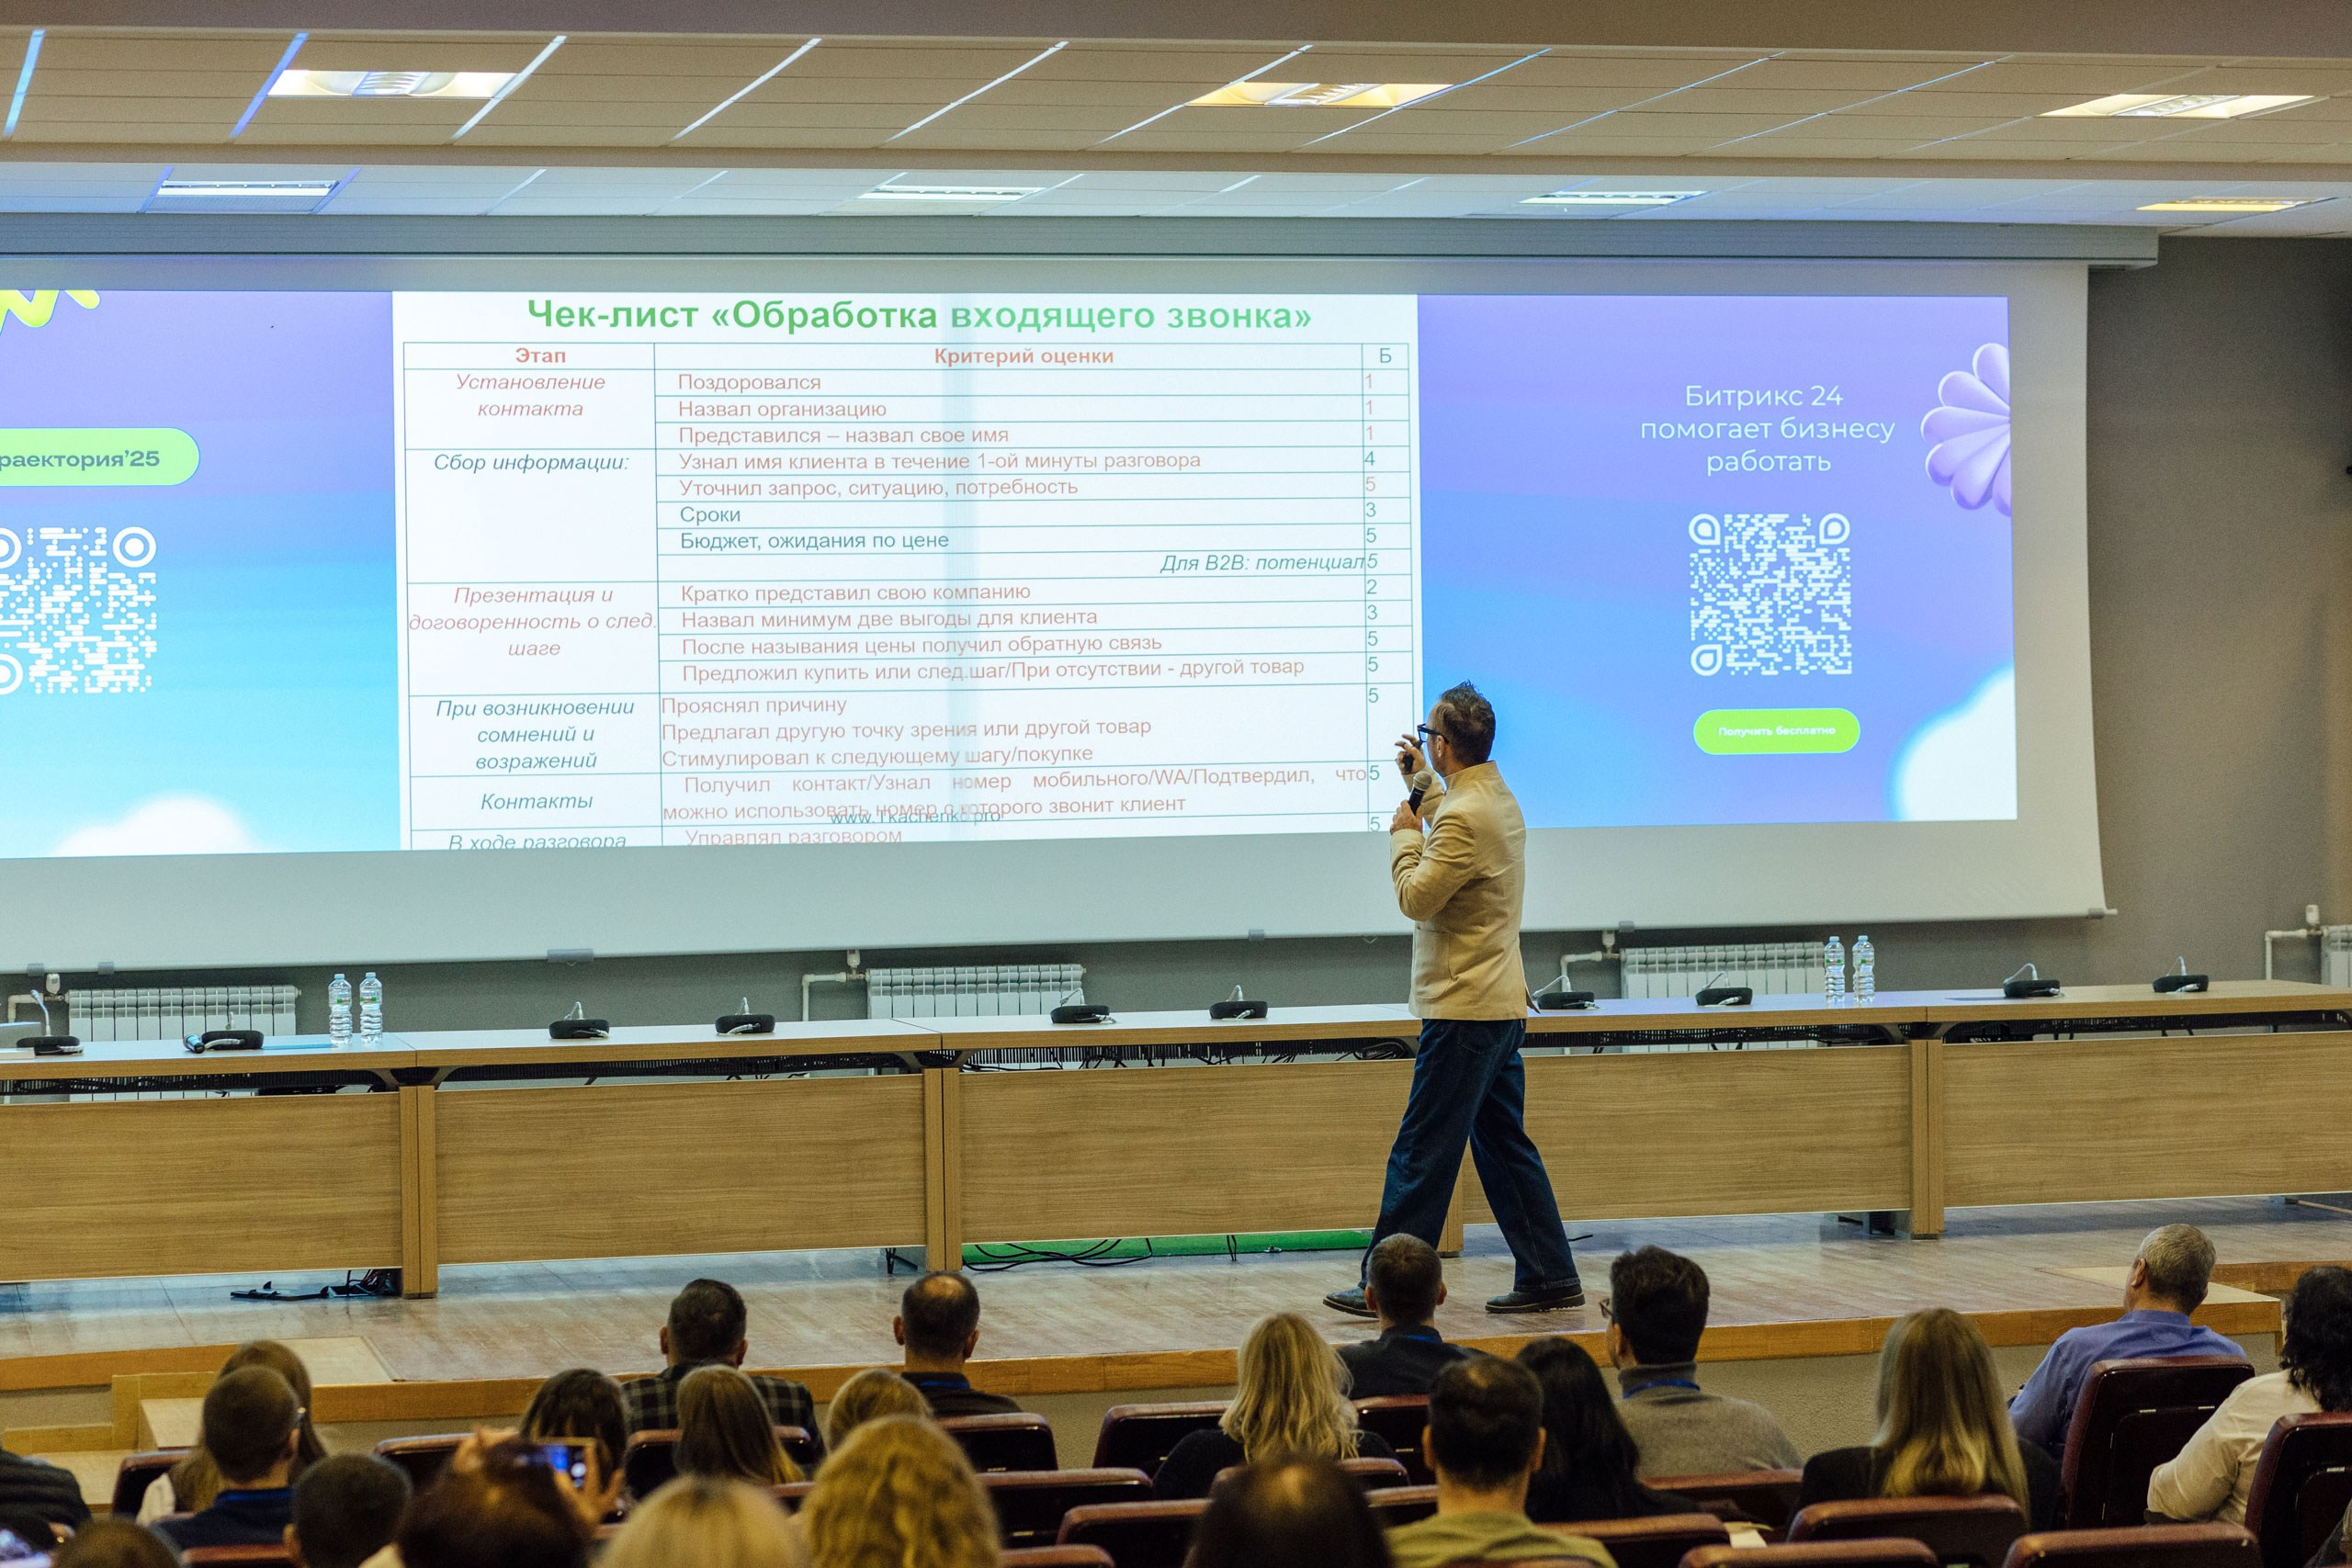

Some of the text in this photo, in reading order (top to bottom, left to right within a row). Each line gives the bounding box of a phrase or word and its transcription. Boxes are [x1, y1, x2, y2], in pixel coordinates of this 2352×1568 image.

[528, 299, 1312, 333] Чек-лист «Обработка входящего звонка»
[515, 348, 566, 364] Этап
[934, 348, 1114, 367] Критерий оценки
[1380, 348, 1391, 363] Б
[457, 374, 605, 390] Установление
[679, 373, 820, 393] Поздоровался
[1366, 374, 1372, 389] 1
[1366, 400, 1373, 414] 1
[1685, 386, 1843, 411] Битрикс 24
[478, 401, 583, 417] контакта
[679, 401, 887, 421] Назвал организацию
[679, 428, 820, 446] Представился
[846, 430, 913, 443] назвал
[921, 430, 965, 443] свое
[972, 430, 1009, 443] имя
[1366, 426, 1373, 440] 1
[1641, 417, 1894, 443] помогает бизнесу
[435, 454, 629, 474] Сбор информации:
[680, 452, 1201, 473] Узнал имя клиента в течение 1-ой минуты разговора
[1364, 451, 1374, 466] 4
[1707, 449, 1831, 477] работать
[680, 479, 1079, 500] Уточнил запрос, ситуацию, потребность
[1366, 477, 1375, 491] 5
[680, 506, 741, 526] Сроки
[1366, 502, 1376, 517] 3
[681, 533, 949, 551] Бюджет, ожидания по цене
[1366, 528, 1376, 543] 5
[1159, 554, 1365, 573] Для B2B: потенциал
[1367, 554, 1377, 569] 5
[682, 585, 1031, 605] Кратко представил свою компанию
[1366, 579, 1377, 594] 2
[455, 587, 613, 607] Презентация и
[1367, 604, 1377, 619] 3
[409, 614, 657, 635] договоренность о след.
[683, 610, 1097, 631] Назвал минимум две выгоды для клиента
[683, 636, 1162, 657] После называния цены получил обратную связь
[1367, 631, 1378, 646] 5
[508, 642, 560, 657] шаге
[684, 665, 797, 684] Предложил
[805, 666, 869, 683] купить
[876, 666, 910, 680] или
[917, 661, 1049, 682] след.шаг/При
[1056, 661, 1161, 679] отсутствии
[1180, 657, 1245, 679] другой
[1251, 660, 1305, 679] товар
[1368, 657, 1378, 671] 5
[1368, 688, 1378, 704] 5
[436, 700, 634, 717] При возникновении
[662, 697, 847, 717] Прояснял причину
[478, 725, 594, 742] сомнений и
[662, 718, 1151, 743] Предлагал другую точку зрения или другой товар
[1718, 725, 1836, 738] Получить бесплатно
[476, 752, 596, 773] возражений
[662, 748, 1093, 770] Стимулировал к следующему шагу/покупке
[1370, 765, 1380, 780] 5
[685, 768, 1366, 795] Получил контакт/Узнал номер мобильного/WA/Подтвердил, что
[481, 794, 594, 810] Контакты
[663, 796, 1186, 819] можно использовать номер с которого звонит клиент
[1370, 817, 1380, 831] 5
[449, 834, 627, 850] В ходе разговора
[685, 830, 902, 845] Управлял разговором
